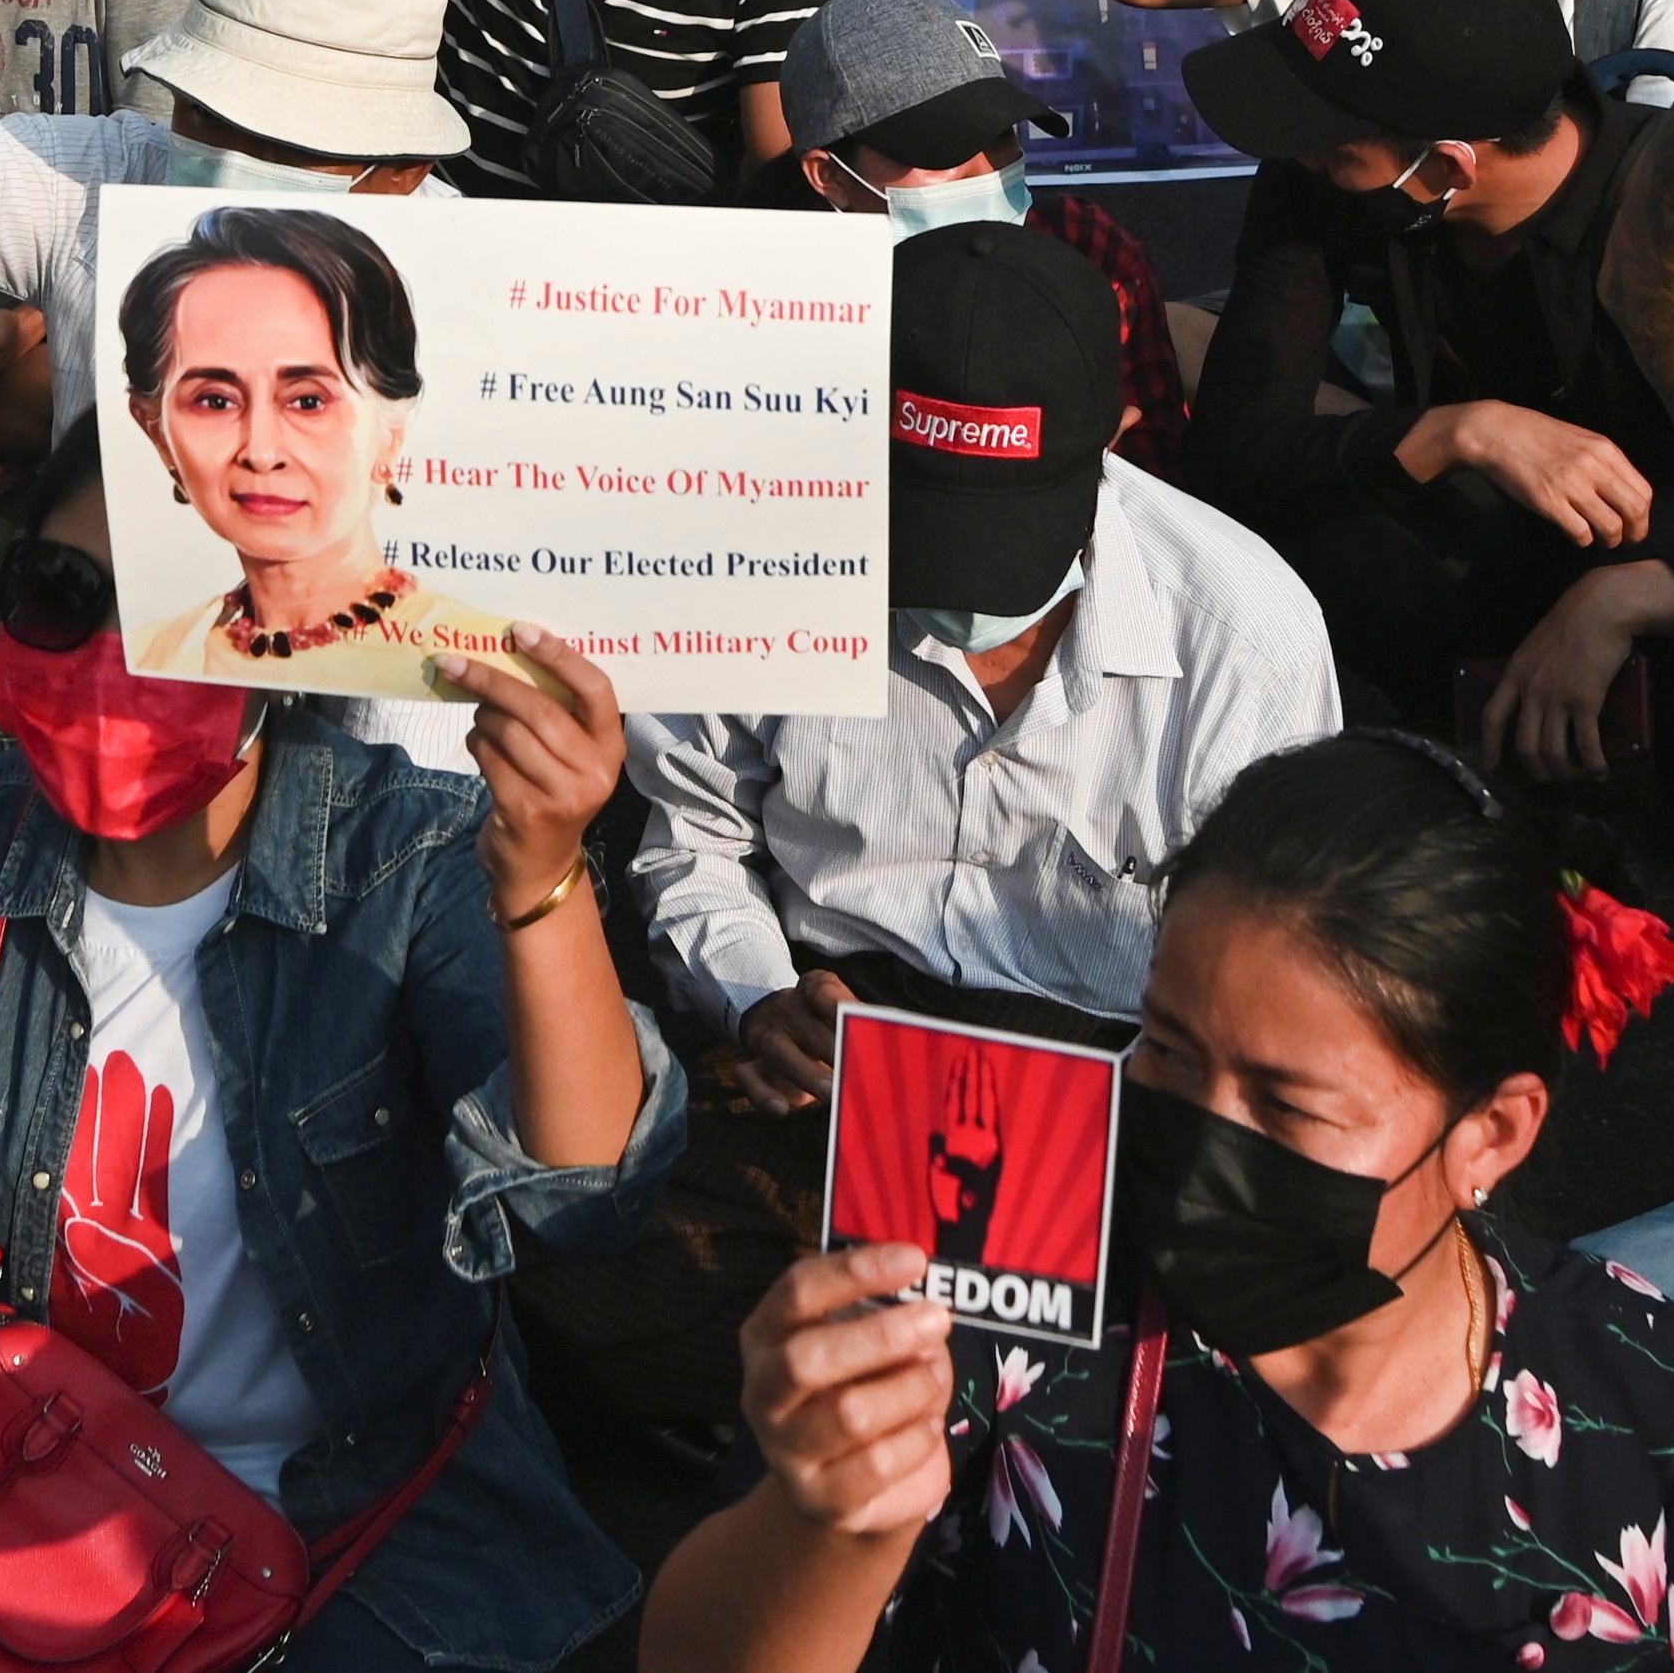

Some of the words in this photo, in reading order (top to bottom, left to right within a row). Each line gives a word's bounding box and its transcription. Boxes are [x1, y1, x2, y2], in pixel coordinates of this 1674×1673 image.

[536, 281, 642, 315] Justice
[652, 285, 707, 318] For
[716, 288, 873, 329] Myanmar
[508, 372, 575, 404] Free
[583, 377, 666, 415] Aung
[676, 380, 733, 411] San
[743, 384, 803, 415] Suu
[814, 386, 870, 423] Kyi
[425, 457, 499, 489] Hear
[507, 461, 567, 492] The
[575, 464, 657, 495] Voice
[666, 468, 710, 498] Of
[716, 470, 872, 505] Myanmar
[410, 541, 522, 574] Release
[530, 546, 594, 577] Our
[603, 549, 715, 578] Elected
[726, 551, 871, 578] President
[378, 620, 424, 648] We
[431, 624, 518, 657] Stand
[559, 628, 642, 658] ainst
[651, 629, 777, 661] Military
[786, 629, 870, 662] Coup
[896, 1261, 1073, 1332] EDOM
